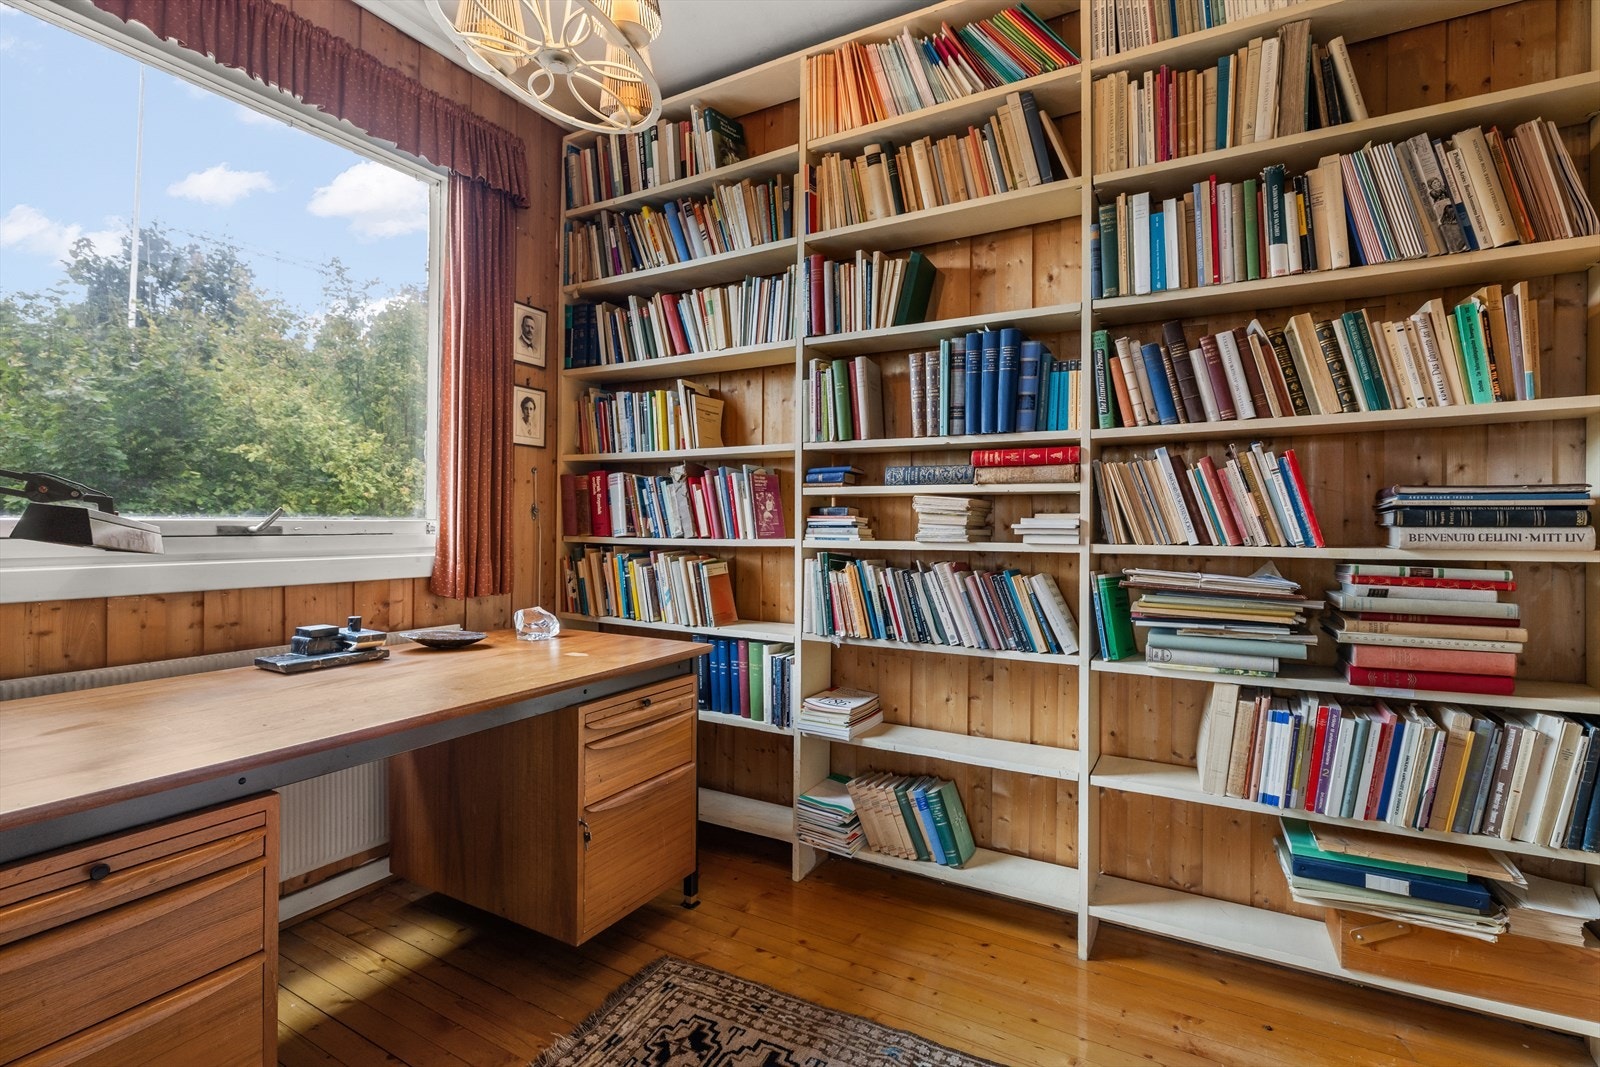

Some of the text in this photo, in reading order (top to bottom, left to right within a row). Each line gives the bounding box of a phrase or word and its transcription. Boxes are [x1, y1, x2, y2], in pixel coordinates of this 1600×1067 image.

[1432, 363, 1441, 375] Das
[1095, 350, 1106, 414] The Humanist Frame
[1437, 380, 1447, 401] KÜNKEL
[1409, 533, 1586, 543] BENVENUTO CELLINI MITT LIV
[1322, 768, 1329, 777] 2
